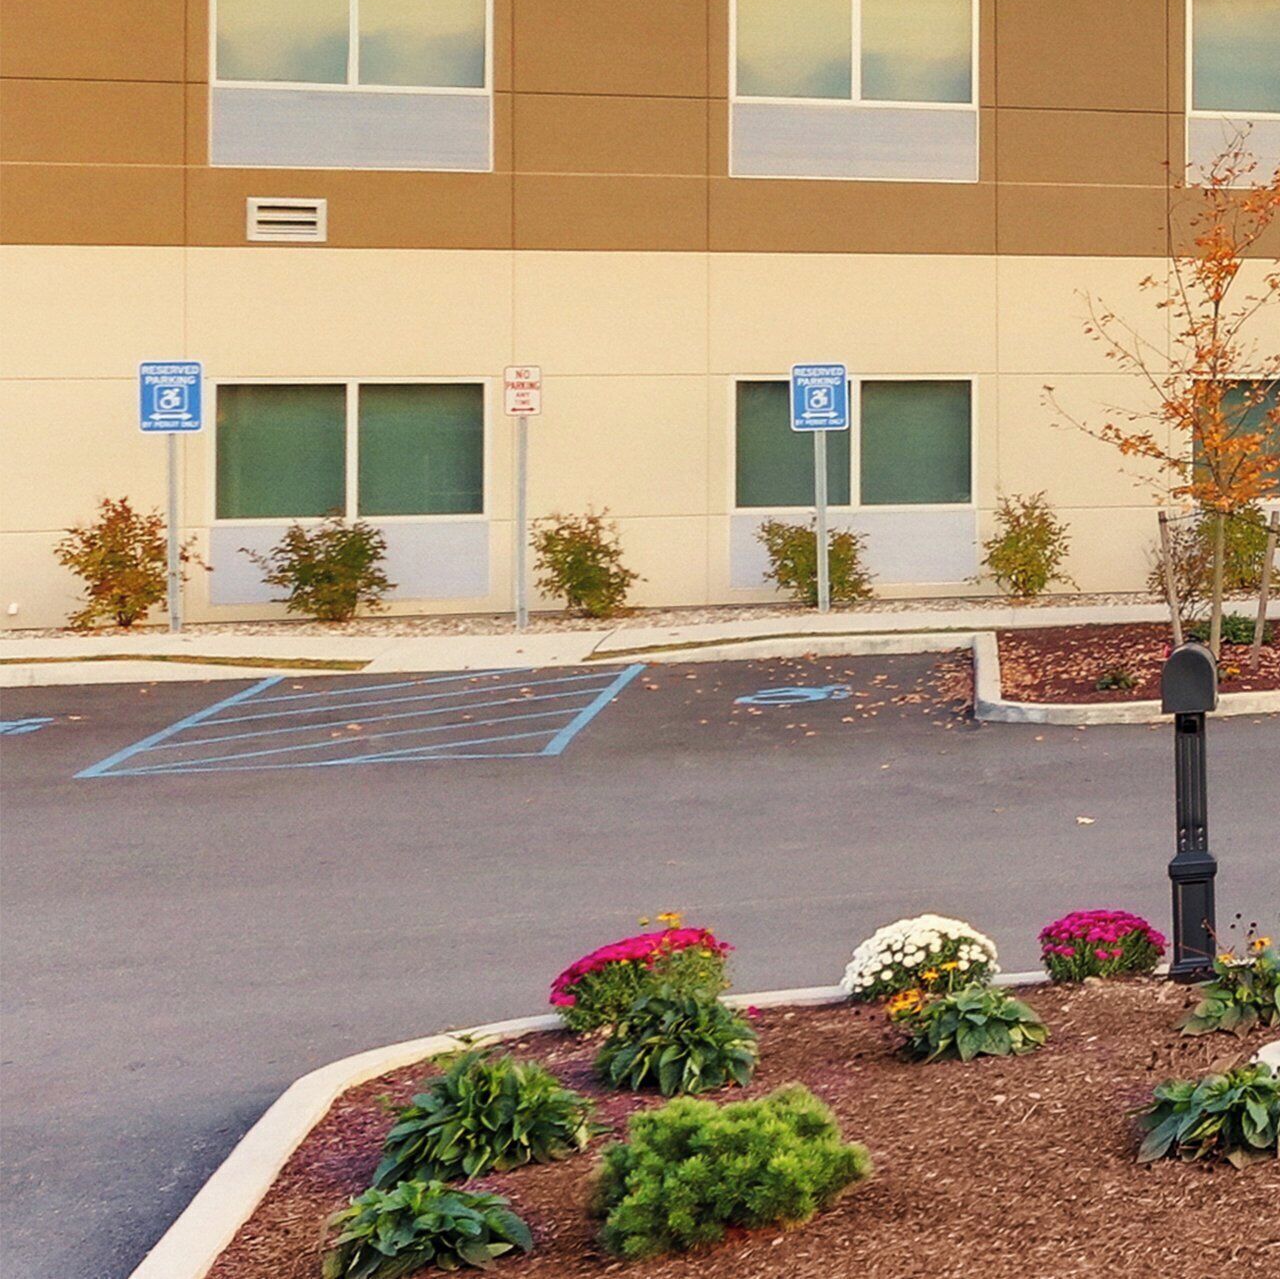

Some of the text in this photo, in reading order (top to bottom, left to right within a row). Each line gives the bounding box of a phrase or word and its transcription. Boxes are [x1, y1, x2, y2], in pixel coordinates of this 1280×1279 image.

[141, 365, 200, 375] RESERVED
[515, 369, 531, 380] NO
[793, 367, 844, 377] RESERVED
[144, 376, 196, 385] PARKING
[797, 377, 841, 386] PARKING
